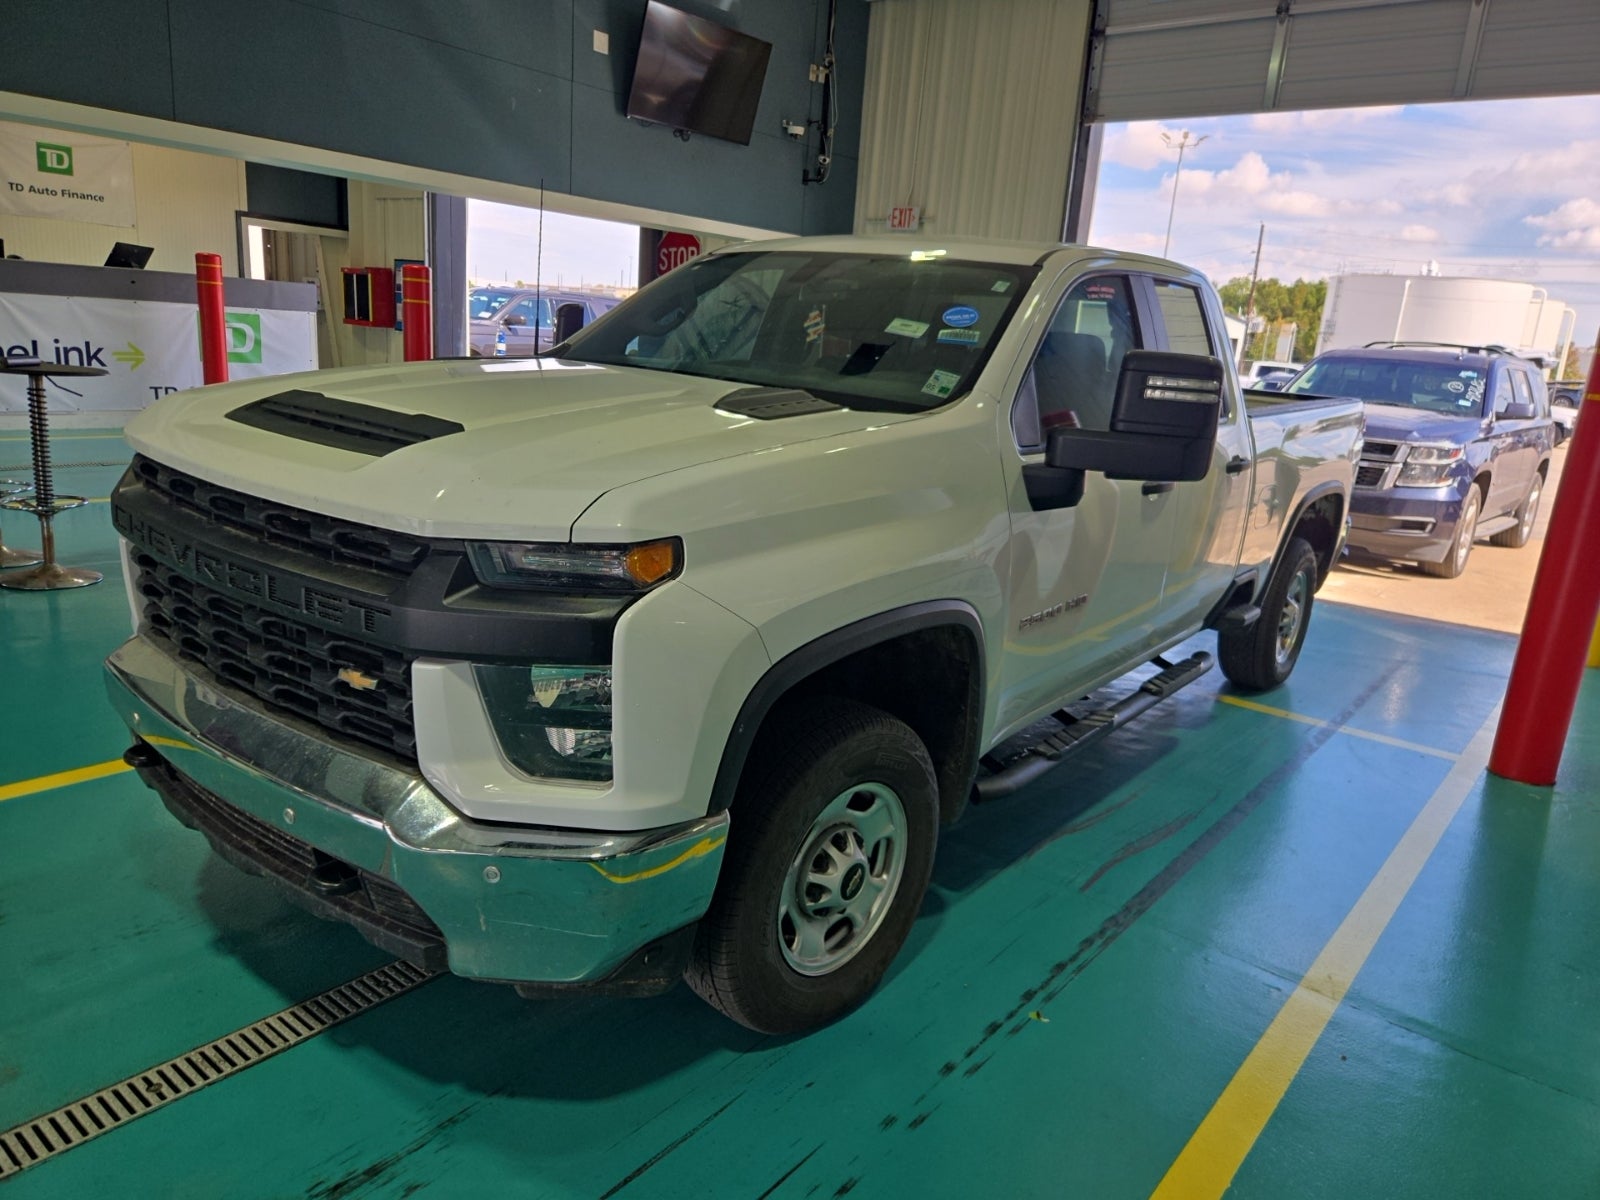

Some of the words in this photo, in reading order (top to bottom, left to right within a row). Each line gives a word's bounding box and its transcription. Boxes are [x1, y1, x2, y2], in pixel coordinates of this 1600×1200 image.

[39, 147, 70, 170] TD
[8, 181, 25, 193] TD
[28, 184, 58, 197] Auto
[61, 189, 105, 203] Finance
[891, 207, 914, 229] EXIT
[658, 245, 698, 271] STOP
[225, 322, 255, 353] D
[0, 338, 107, 367] eLink
[114, 504, 393, 633] CHEVROLET
